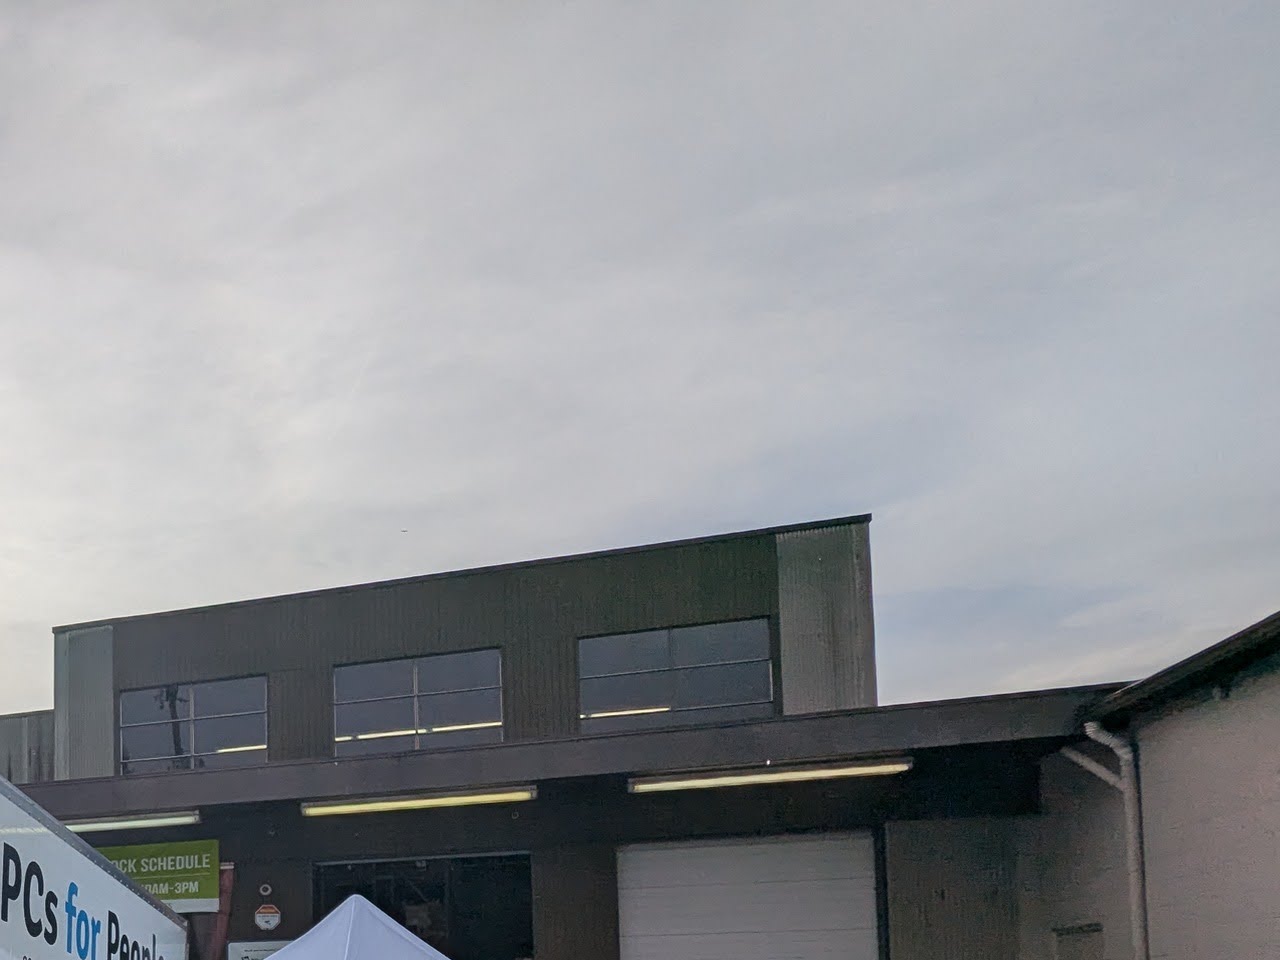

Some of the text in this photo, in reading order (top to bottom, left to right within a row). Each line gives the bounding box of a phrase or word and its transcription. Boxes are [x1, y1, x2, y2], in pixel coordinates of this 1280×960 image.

[140, 853, 211, 872] SCHEDULE
[1, 841, 58, 945] PCs
[142, 881, 199, 894] 0AM-3PM
